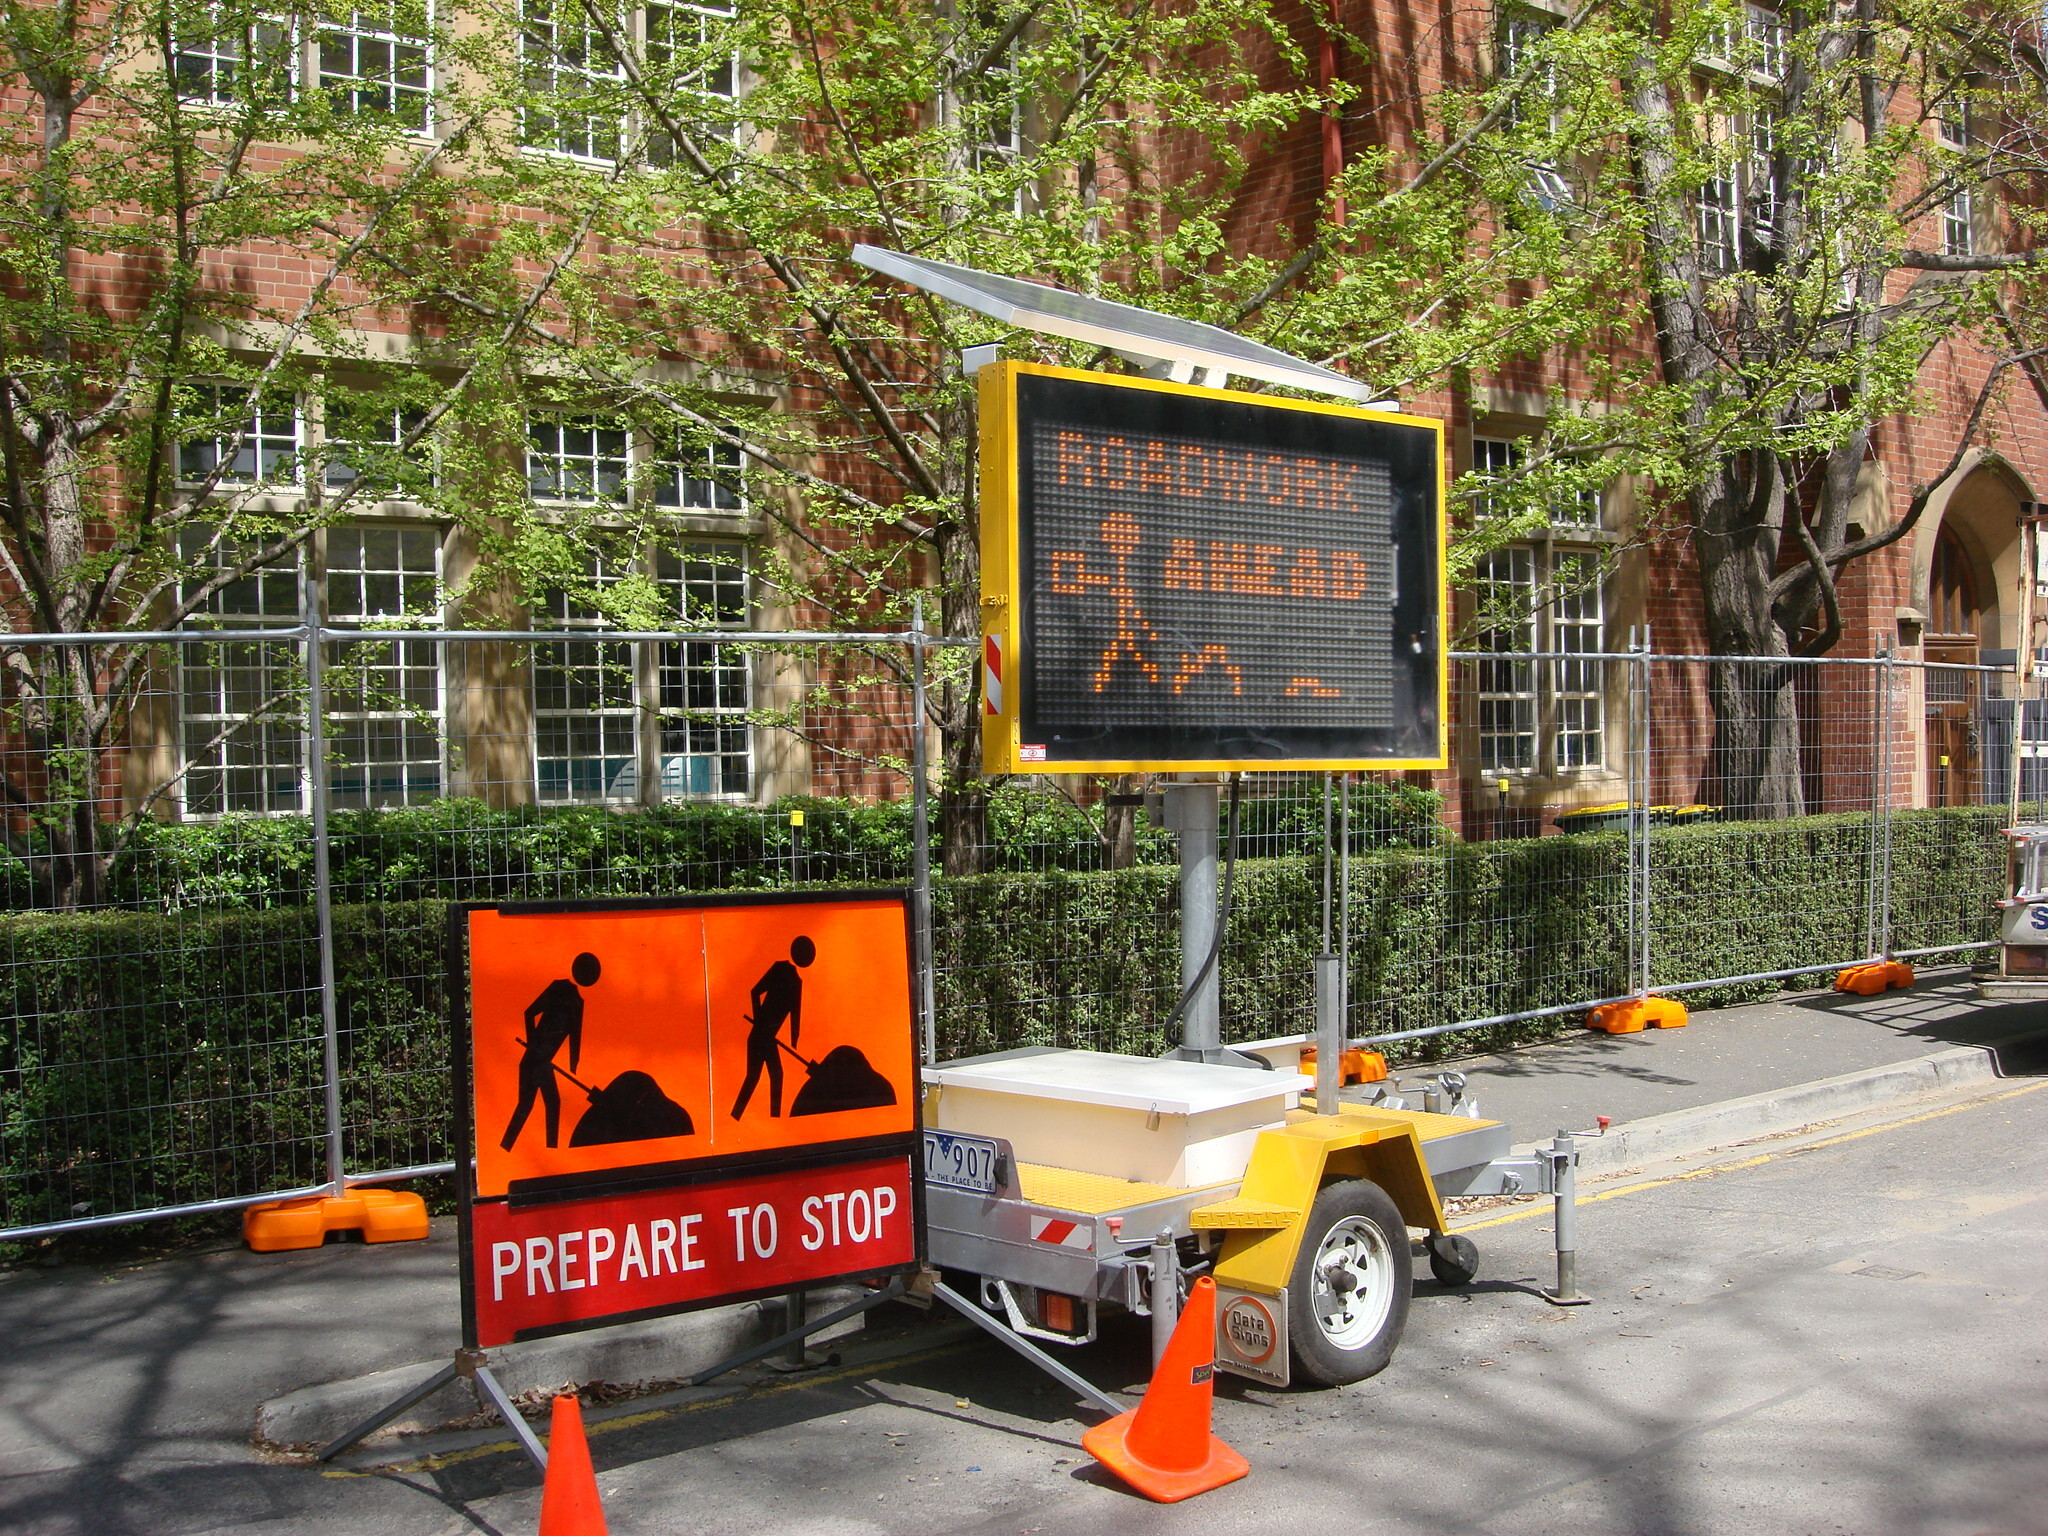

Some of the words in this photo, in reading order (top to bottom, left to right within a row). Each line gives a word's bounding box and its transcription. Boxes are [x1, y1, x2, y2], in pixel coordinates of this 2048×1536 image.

[1059, 431, 1359, 512] ROADWORK
[1164, 538, 1367, 600] AHEAD
[937, 1173, 949, 1182] THE
[952, 1176, 970, 1186] PLACE
[974, 1180, 982, 1188] TO
[953, 1144, 993, 1181] 907
[492, 1213, 706, 1301] PREPARE
[728, 1202, 779, 1262] TO
[801, 1186, 897, 1251] STOP
[1232, 1325, 1269, 1346] Signs
[1233, 1311, 1264, 1331] Data
